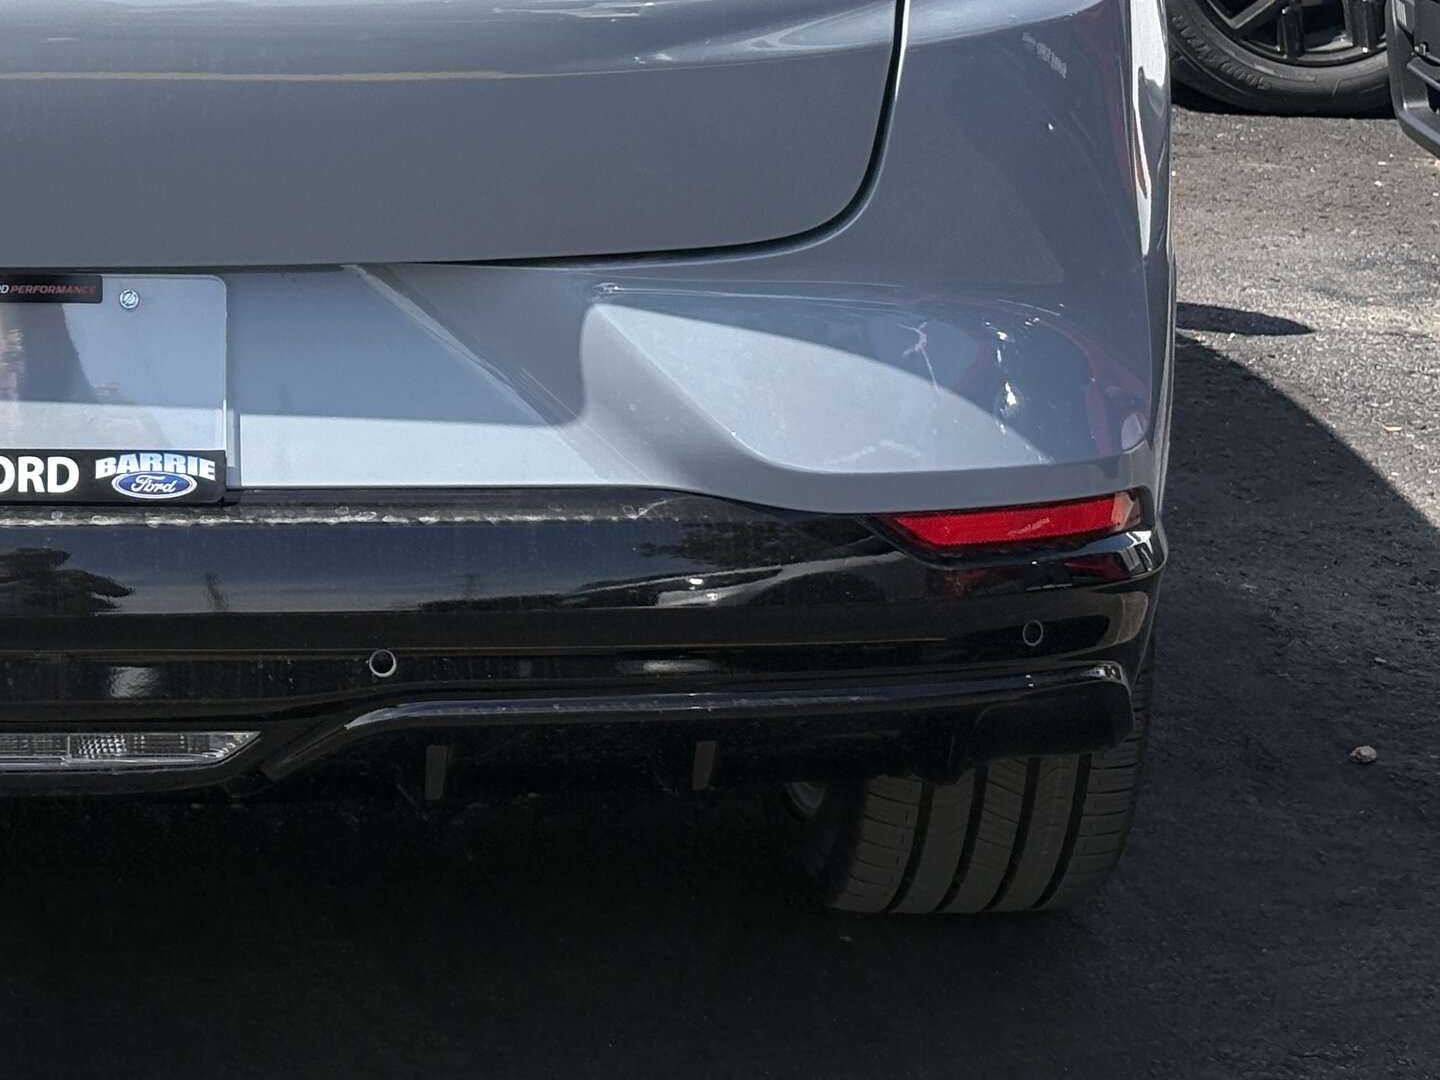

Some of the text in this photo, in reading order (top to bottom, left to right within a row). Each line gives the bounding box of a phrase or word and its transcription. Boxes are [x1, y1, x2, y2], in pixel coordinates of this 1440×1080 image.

[10, 284, 97, 296] PERFORMANCE
[95, 452, 216, 481] BARRIE
[130, 474, 177, 493] Ford
